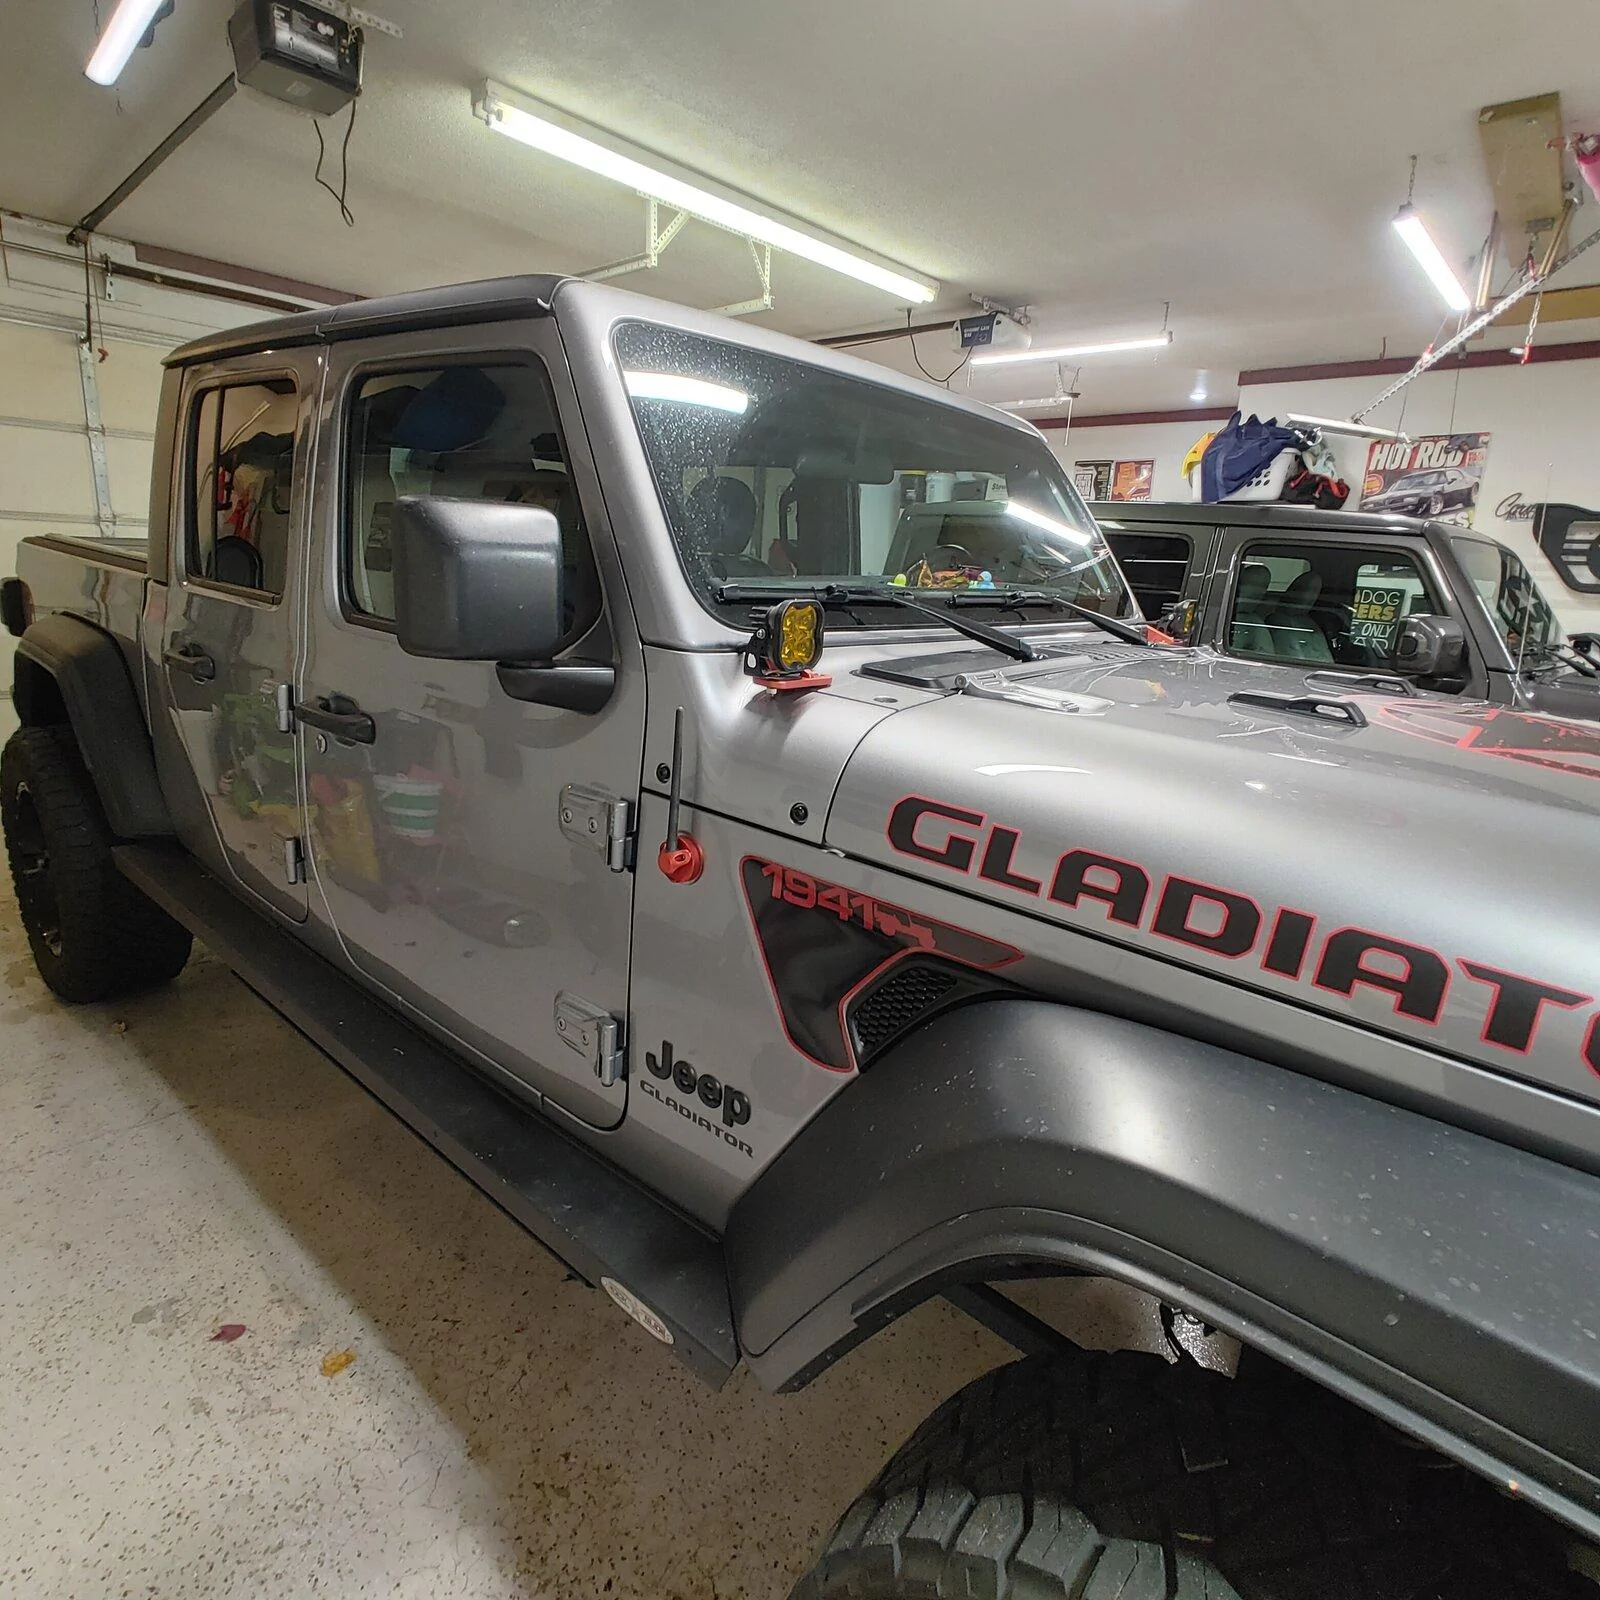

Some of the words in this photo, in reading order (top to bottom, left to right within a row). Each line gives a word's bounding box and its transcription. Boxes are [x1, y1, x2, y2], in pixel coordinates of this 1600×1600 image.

[1368, 441, 1419, 470] HOT
[1361, 589, 1401, 606] DOG
[1361, 623, 1395, 638] ONLY
[761, 863, 875, 930] 1941
[884, 792, 1600, 1080] GLADIAT
[645, 1039, 752, 1128] Jeep
[639, 1079, 754, 1160] GLADIATOR
